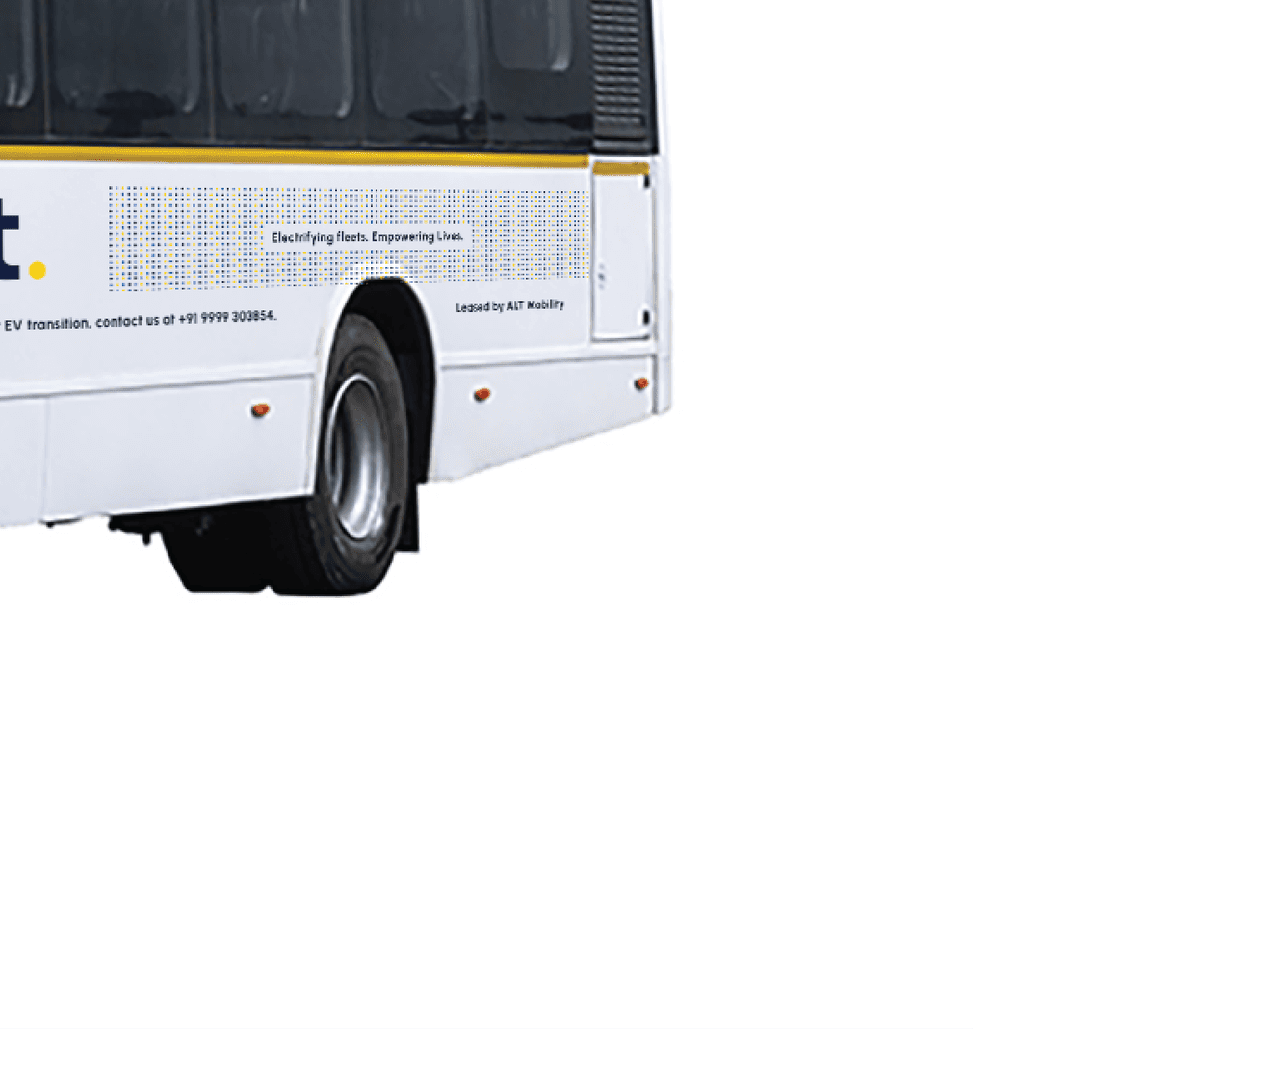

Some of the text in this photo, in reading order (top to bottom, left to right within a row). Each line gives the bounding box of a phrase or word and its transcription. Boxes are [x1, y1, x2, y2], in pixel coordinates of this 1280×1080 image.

[271, 230, 335, 247] Electrifying
[372, 230, 435, 246] Empowering
[436, 230, 464, 242] Lives.
[455, 298, 565, 314] Leased by ALT Mobility
[4, 319, 23, 332] EV
[26, 317, 92, 332] transition,
[95, 315, 143, 328] contact
[145, 316, 160, 327] us
[162, 313, 176, 326] at
[178, 312, 198, 325] +91
[200, 311, 230, 325] 9999
